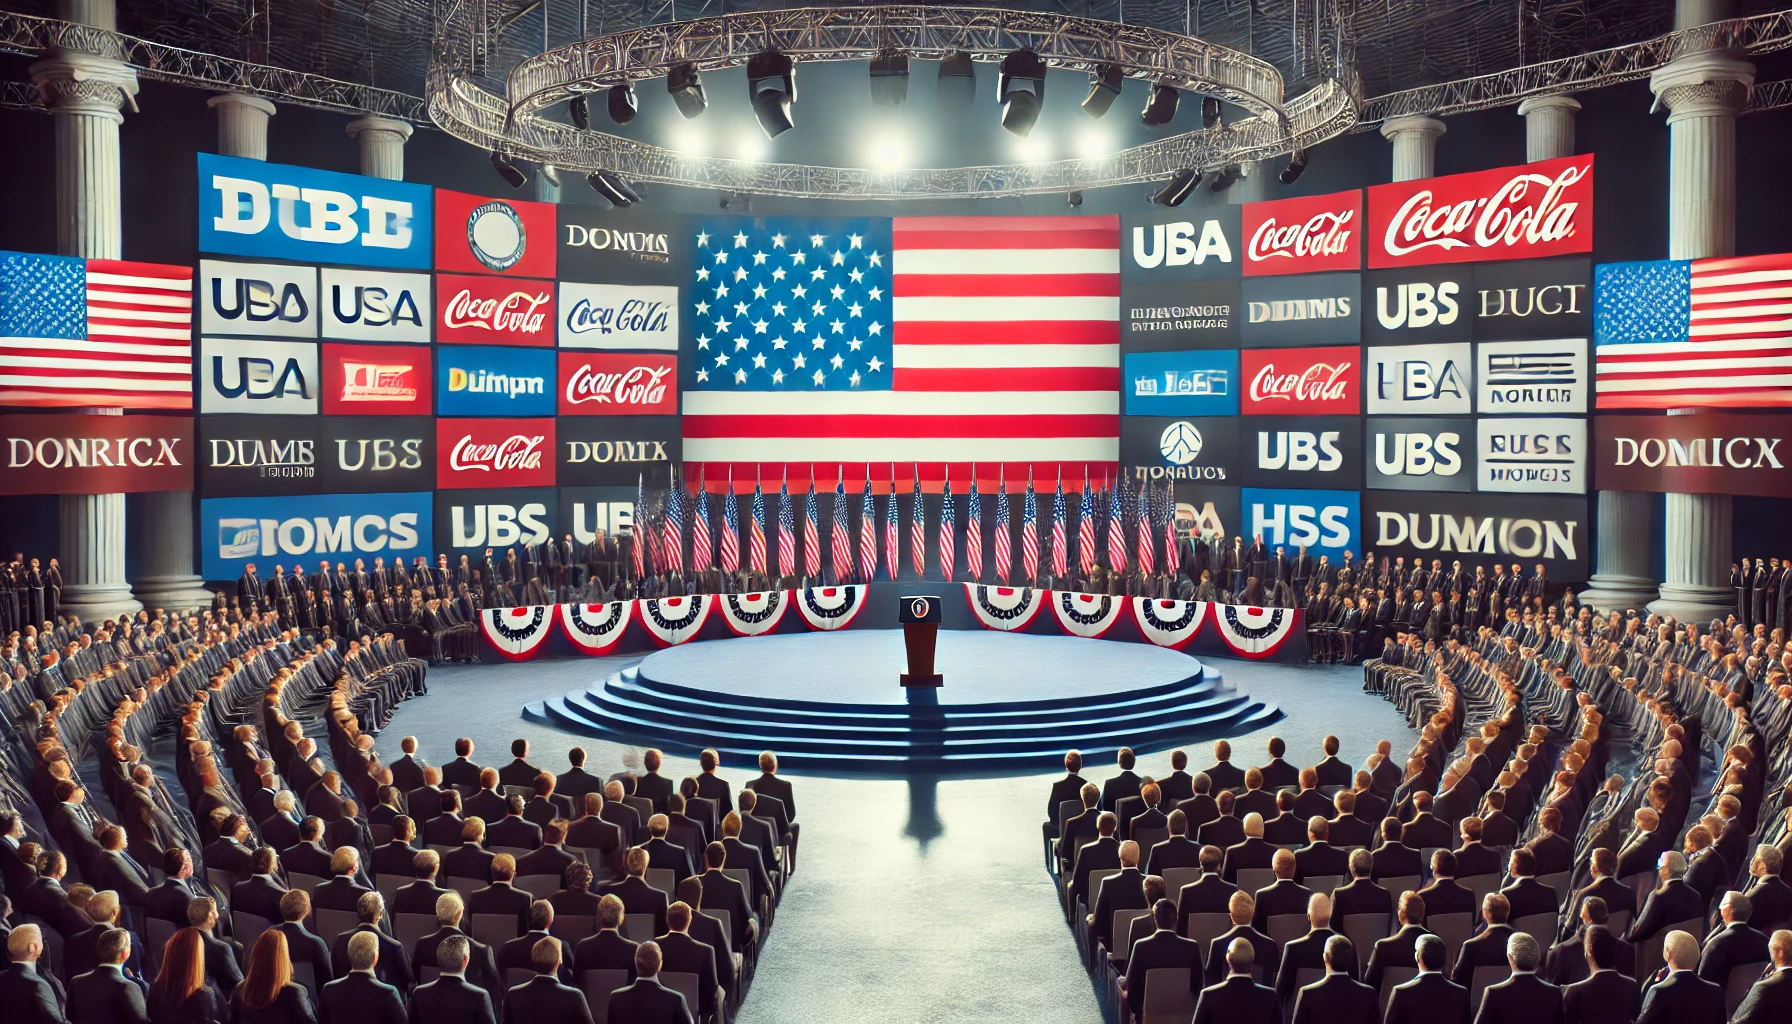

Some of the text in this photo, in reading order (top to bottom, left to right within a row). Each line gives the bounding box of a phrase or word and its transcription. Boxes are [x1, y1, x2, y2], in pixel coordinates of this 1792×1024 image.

[1133, 220, 1231, 269] UBA
[332, 284, 421, 327] USA
[1377, 281, 1459, 330] UBS
[1258, 431, 1343, 471] UBS
[1375, 433, 1461, 476] UBS
[452, 504, 548, 548] UBS
